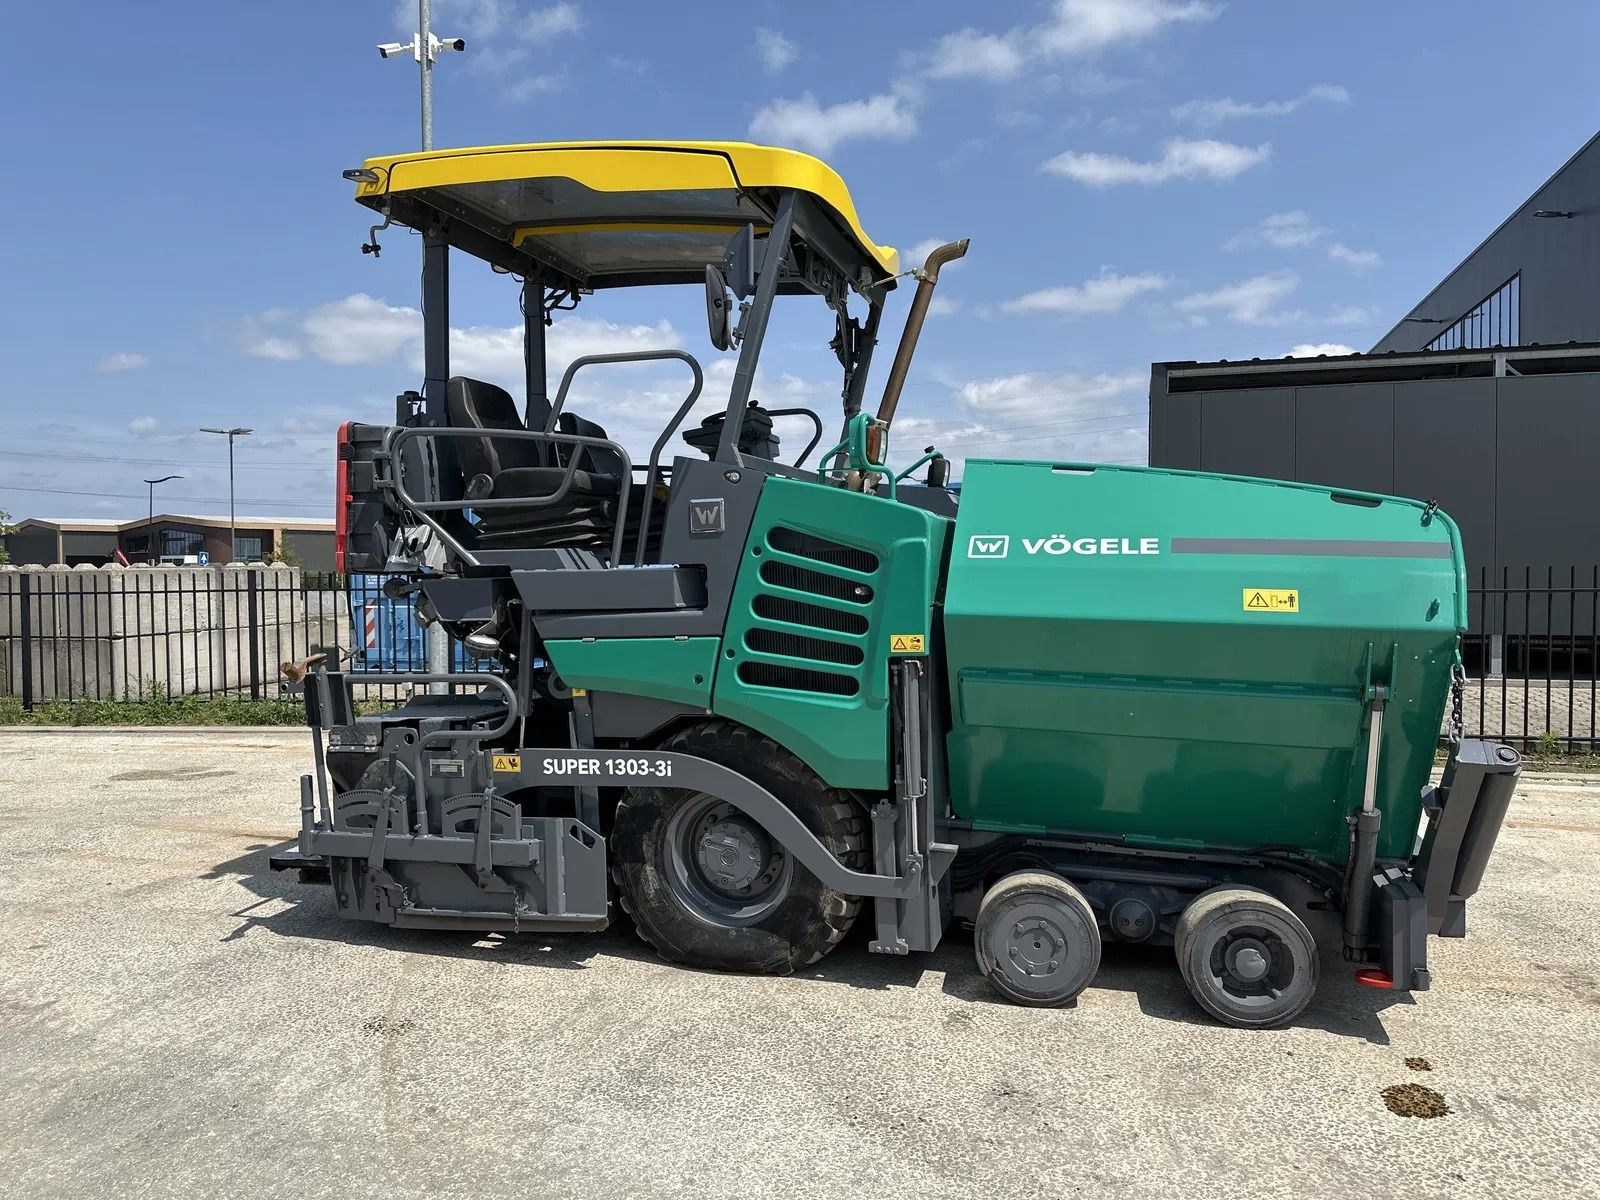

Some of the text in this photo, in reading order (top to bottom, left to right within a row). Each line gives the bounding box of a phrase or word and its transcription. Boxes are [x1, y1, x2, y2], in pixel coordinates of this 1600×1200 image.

[1021, 534, 1160, 555] VÖGELE
[543, 758, 672, 777] SUPER 1303-3i
